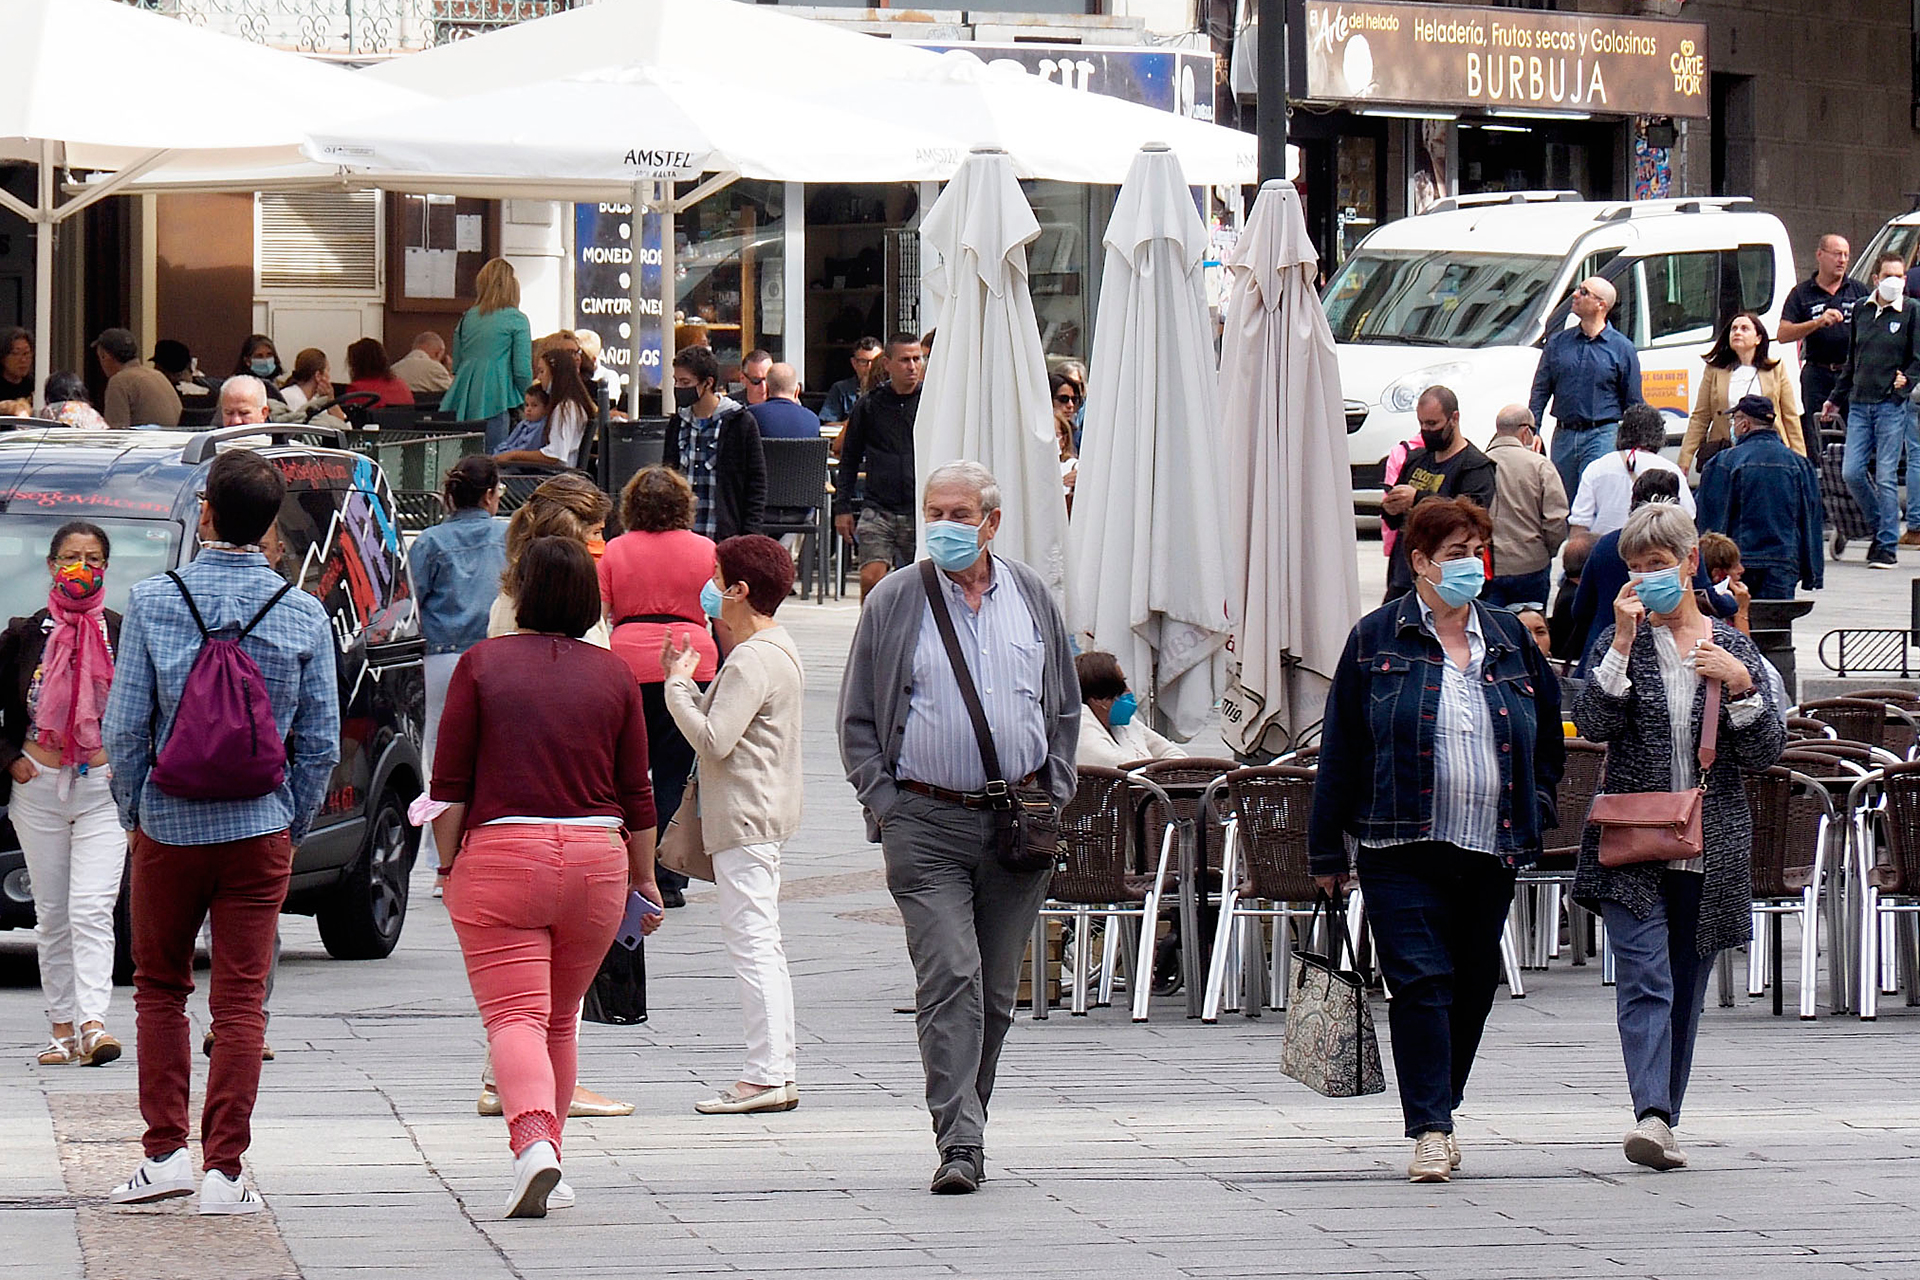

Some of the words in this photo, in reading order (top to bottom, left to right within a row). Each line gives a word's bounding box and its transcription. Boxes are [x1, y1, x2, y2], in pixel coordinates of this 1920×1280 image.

[1313, 5, 1350, 54] Arte
[1349, 12, 1365, 29] del
[1365, 12, 1400, 32] helado
[1414, 18, 1488, 47] Heladería,
[1491, 22, 1532, 48] Frutos
[1535, 28, 1576, 51] secos
[1578, 30, 1588, 56] y
[1590, 28, 1656, 56] Golosinas
[1670, 52, 1705, 76] CARTE
[1467, 52, 1607, 104] BURBUJA
[623, 148, 692, 169] AMSTEL
[599, 202, 649, 215] BOLSS
[582, 246, 662, 266] MONEDROS
[581, 297, 663, 316] CINTURNE
